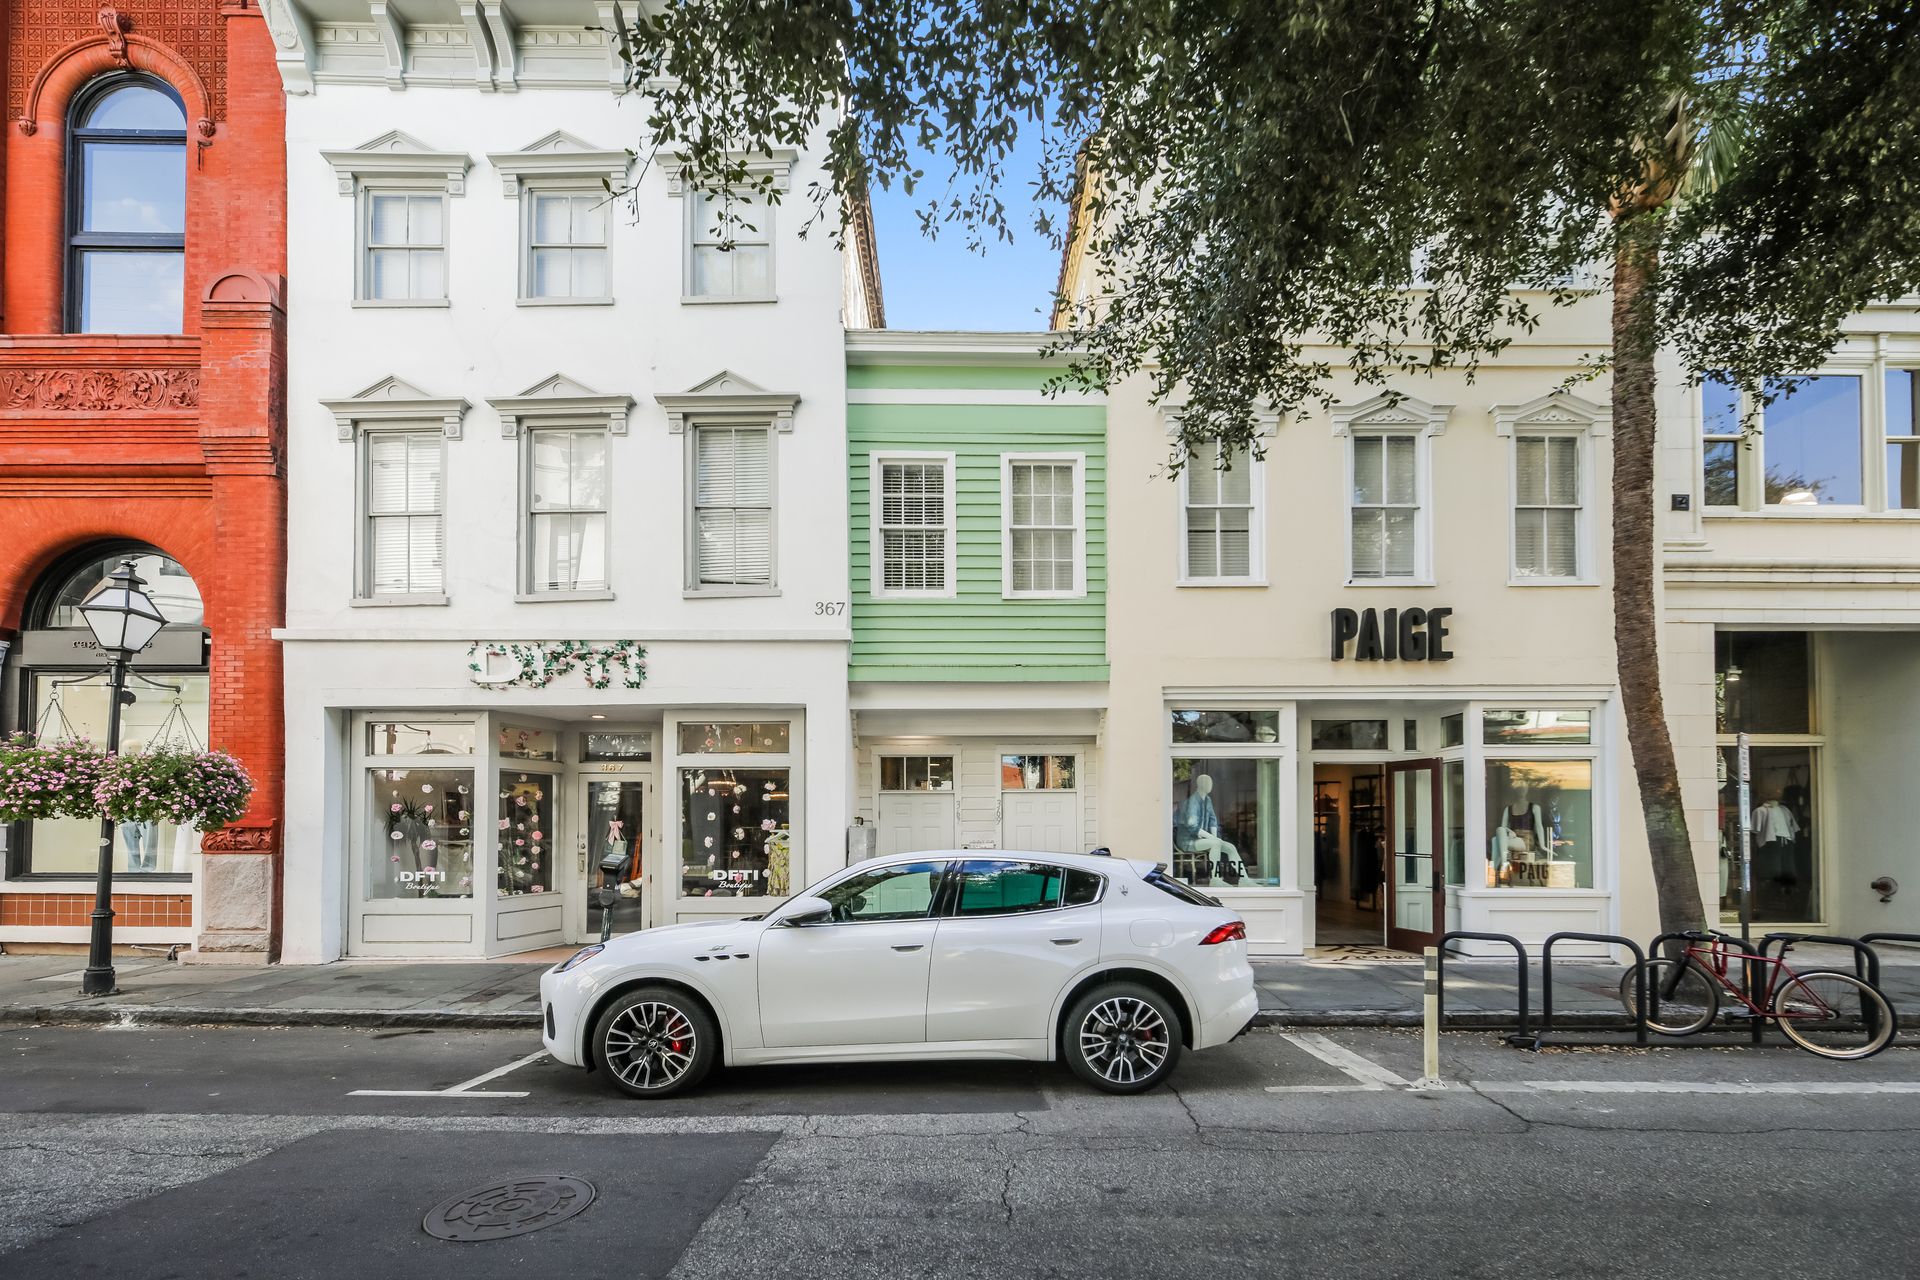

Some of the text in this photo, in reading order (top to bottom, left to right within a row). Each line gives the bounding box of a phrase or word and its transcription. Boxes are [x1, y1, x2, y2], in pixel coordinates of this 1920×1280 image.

[814, 601, 846, 616] 367
[1331, 607, 1453, 661] PAIGE
[400, 871, 446, 882] DFTI
[713, 869, 759, 881] DFTI
